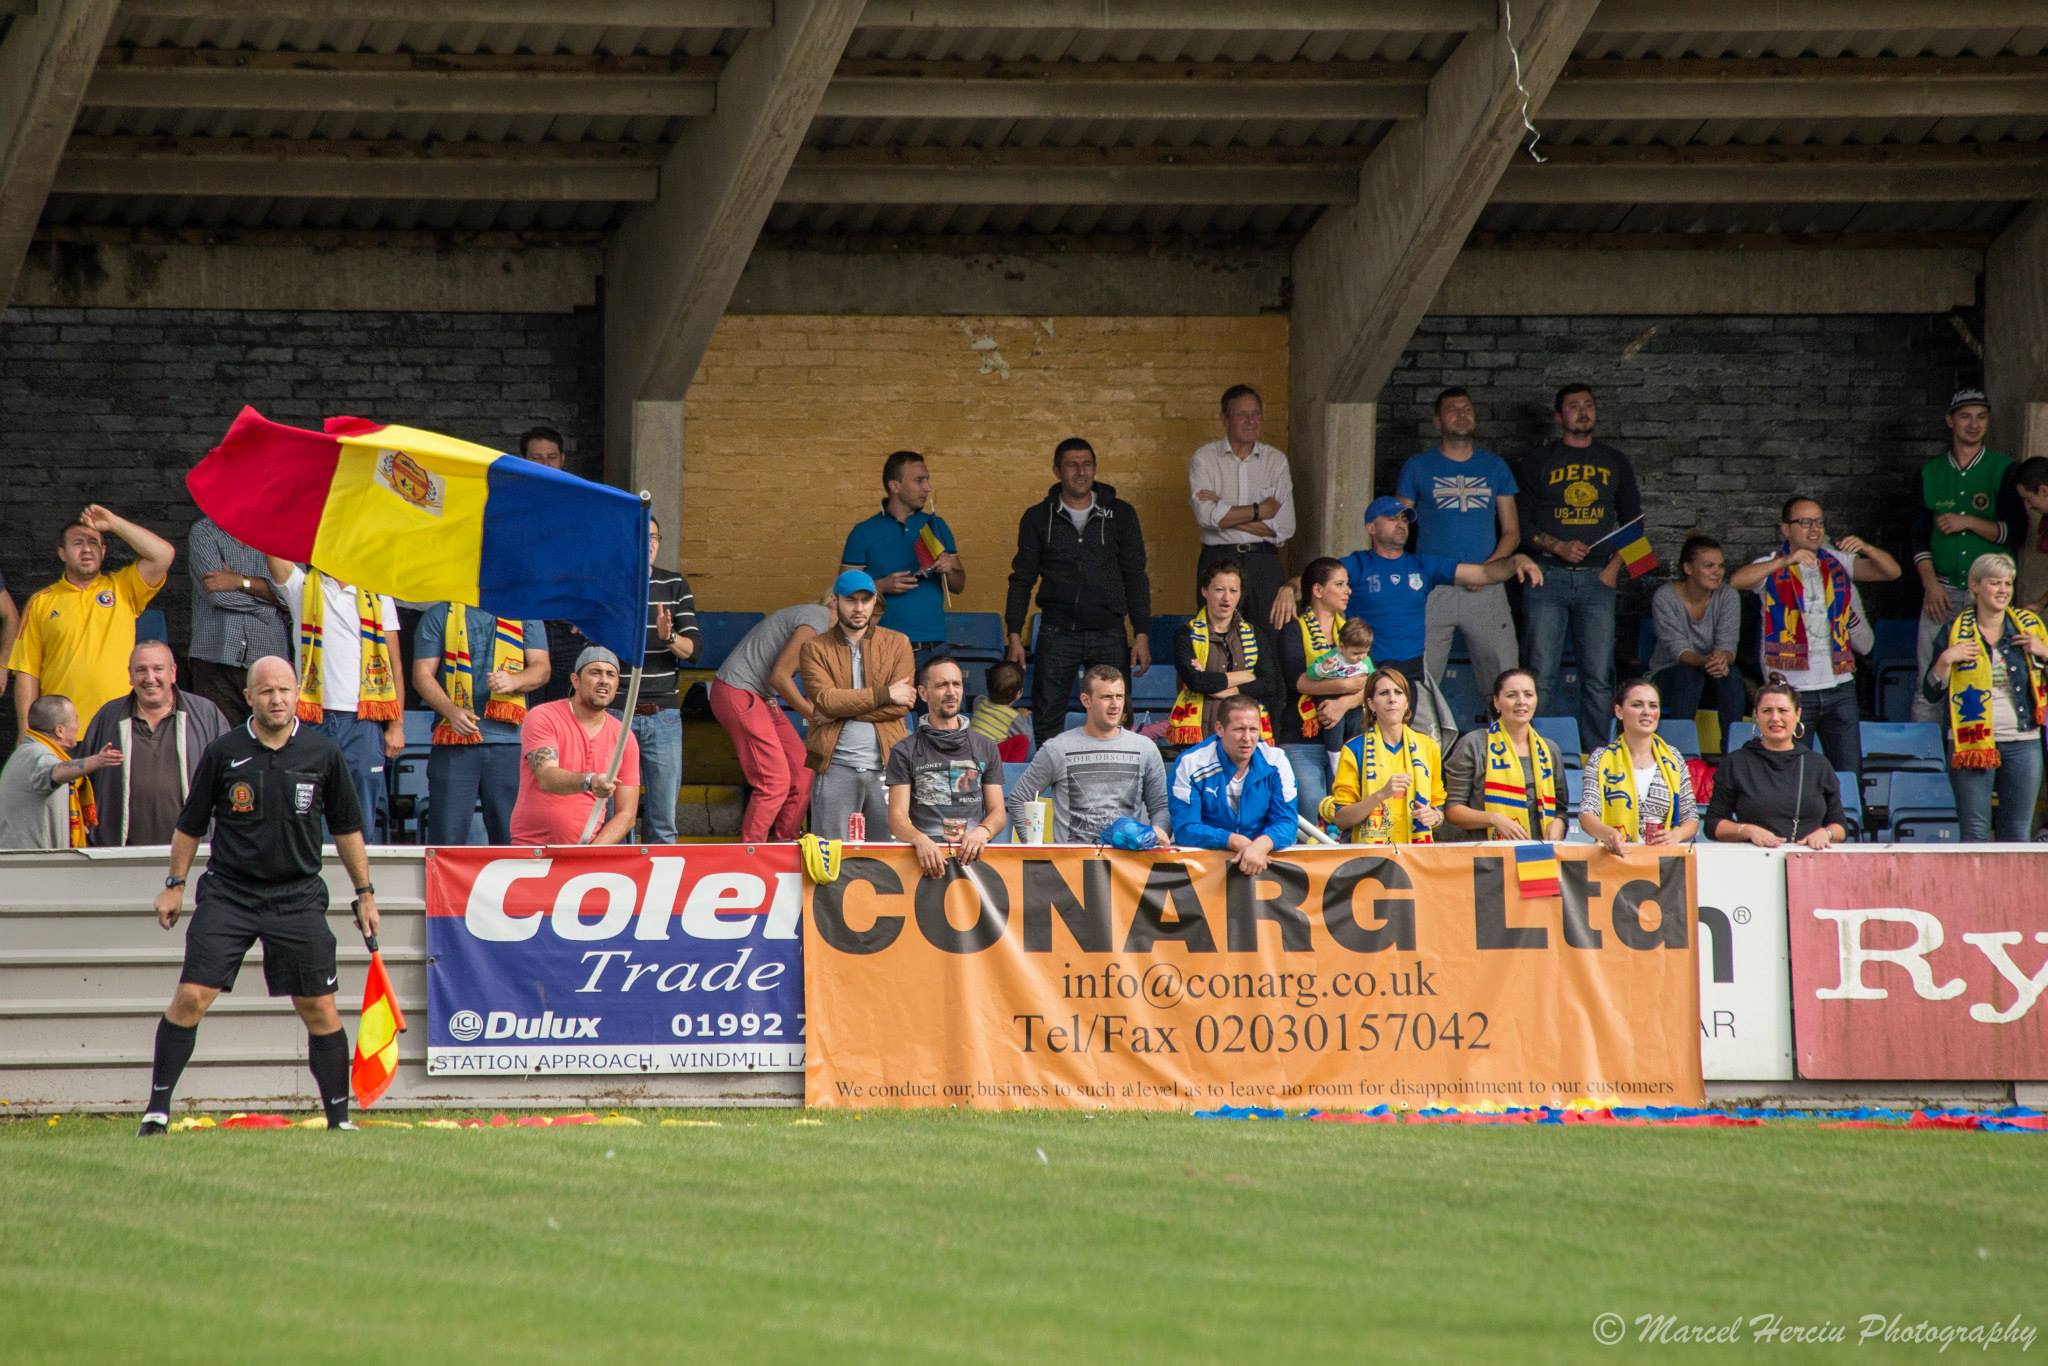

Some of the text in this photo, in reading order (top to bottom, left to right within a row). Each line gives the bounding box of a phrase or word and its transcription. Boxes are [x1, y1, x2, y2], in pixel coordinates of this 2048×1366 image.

[1549, 464, 1611, 486] DEPT
[1366, 574, 1382, 593] 15
[812, 855, 1689, 955] CONARG Ltd
[574, 948, 786, 993] Trade
[1062, 960, 1438, 1009] info@conarg.co.uk
[456, 1010, 602, 1040] ICI Dulux
[671, 1012, 784, 1038] 01992
[1013, 1010, 1491, 1055] Tel/Fax 02030157042
[435, 1054, 529, 1072] STATION
[536, 1052, 661, 1071] APPROACH,
[670, 1051, 780, 1069] WINDMILL
[836, 1081, 863, 1097] We
[869, 1081, 937, 1097] conduct
[977, 1080, 1049, 1097] business
[1055, 1083, 1072, 1097] to
[1077, 1080, 1115, 1097] such
[1138, 1081, 1177, 1097] level
[1185, 1086, 1200, 1097] as
[1207, 1083, 1224, 1097] to
[1231, 1081, 1276, 1097] leave
[1282, 1086, 1302, 1097] no
[1308, 1085, 1353, 1096] room
[1360, 1079, 1384, 1096] for
[1389, 1078, 1524, 1098] disappointment
[1529, 1081, 1546, 1094] to
[1551, 1081, 1581, 1093] our
[1587, 1080, 1674, 1094] customers
